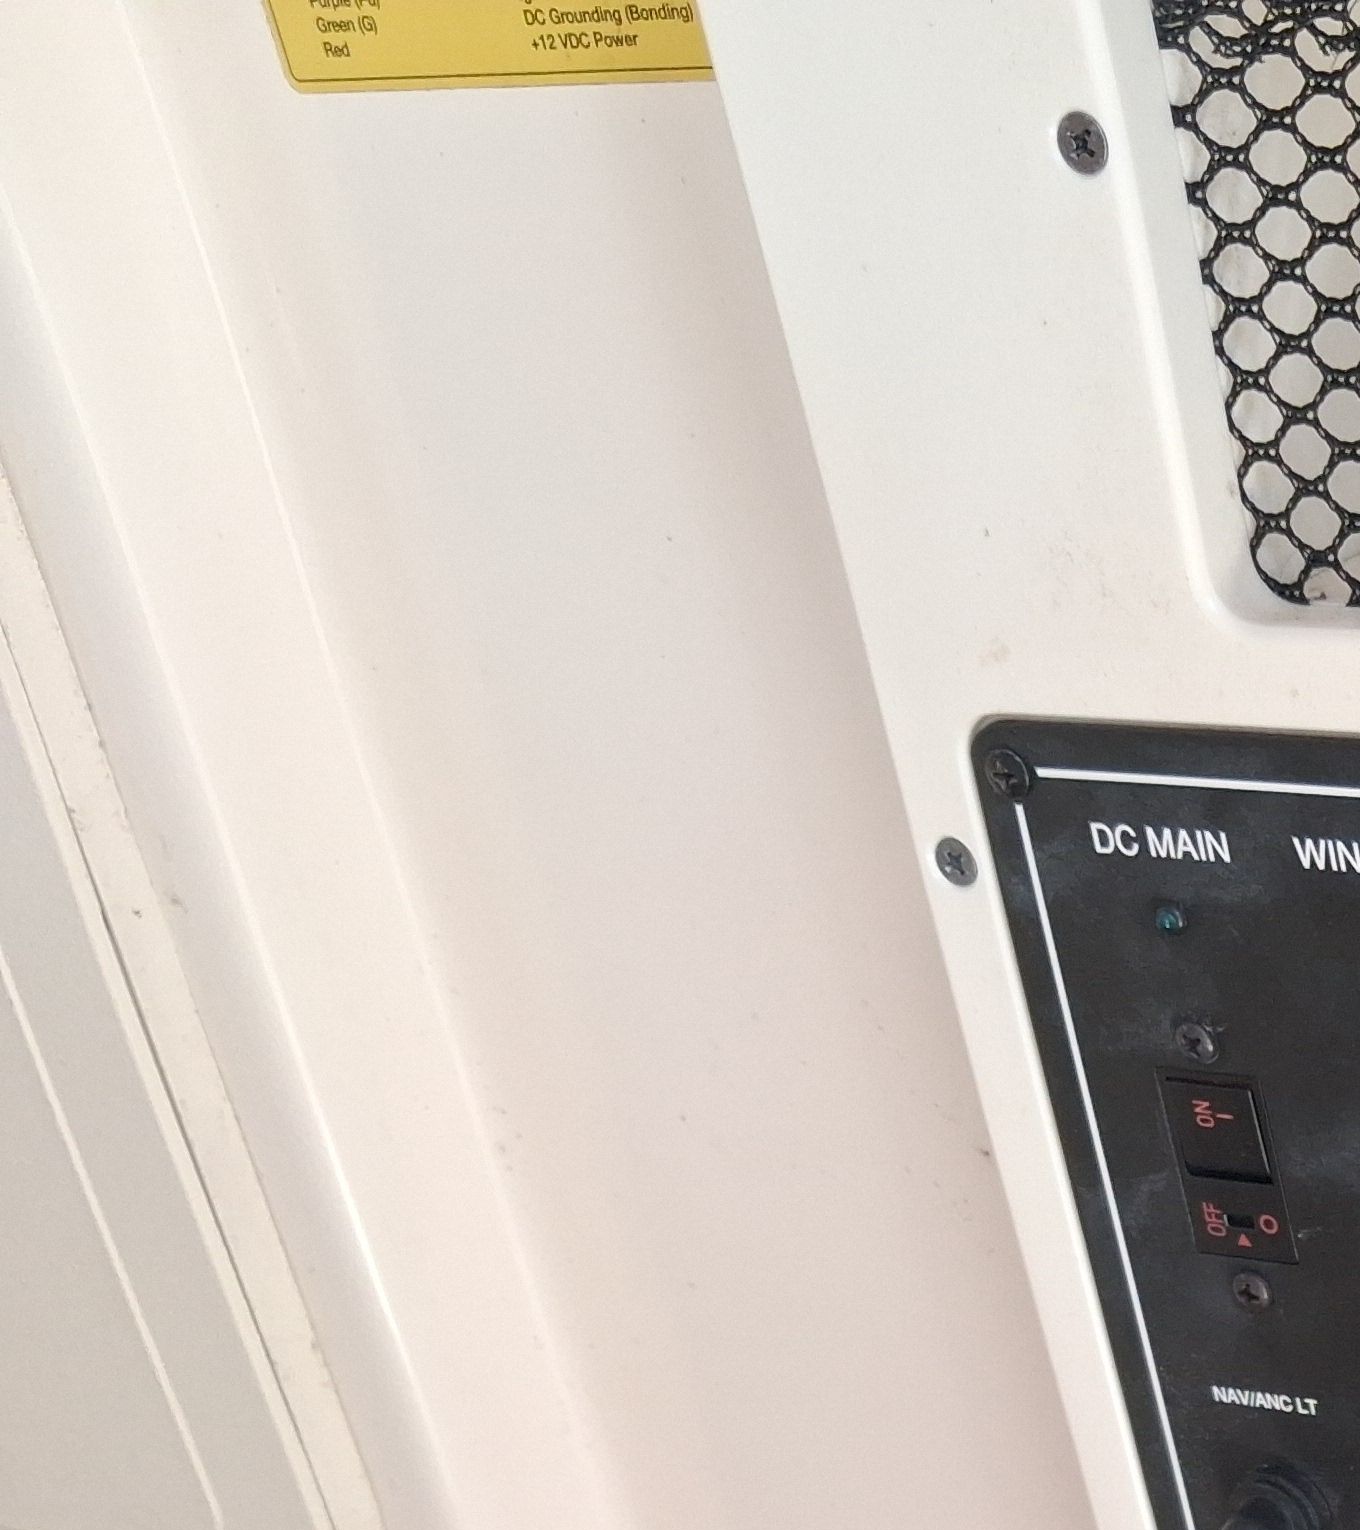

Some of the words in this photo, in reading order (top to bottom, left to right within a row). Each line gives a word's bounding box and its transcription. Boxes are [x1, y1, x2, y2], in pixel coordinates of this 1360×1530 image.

[315, 16, 356, 33] Green
[358, 15, 378, 36] (G)
[523, 9, 546, 26] DC
[549, 6, 622, 26] Grounding
[624, 3, 694, 24] (Bonding)
[322, 41, 351, 58] Red
[531, 34, 557, 51] +12
[558, 33, 590, 50] VDC
[592, 31, 638, 48] Power
[1089, 822, 1140, 857] DC
[1145, 826, 1231, 864] MAIN
[1192, 1099, 1216, 1129] ON
[1202, 1202, 1227, 1237] OFF
[1294, 1397, 1318, 1416] LT
